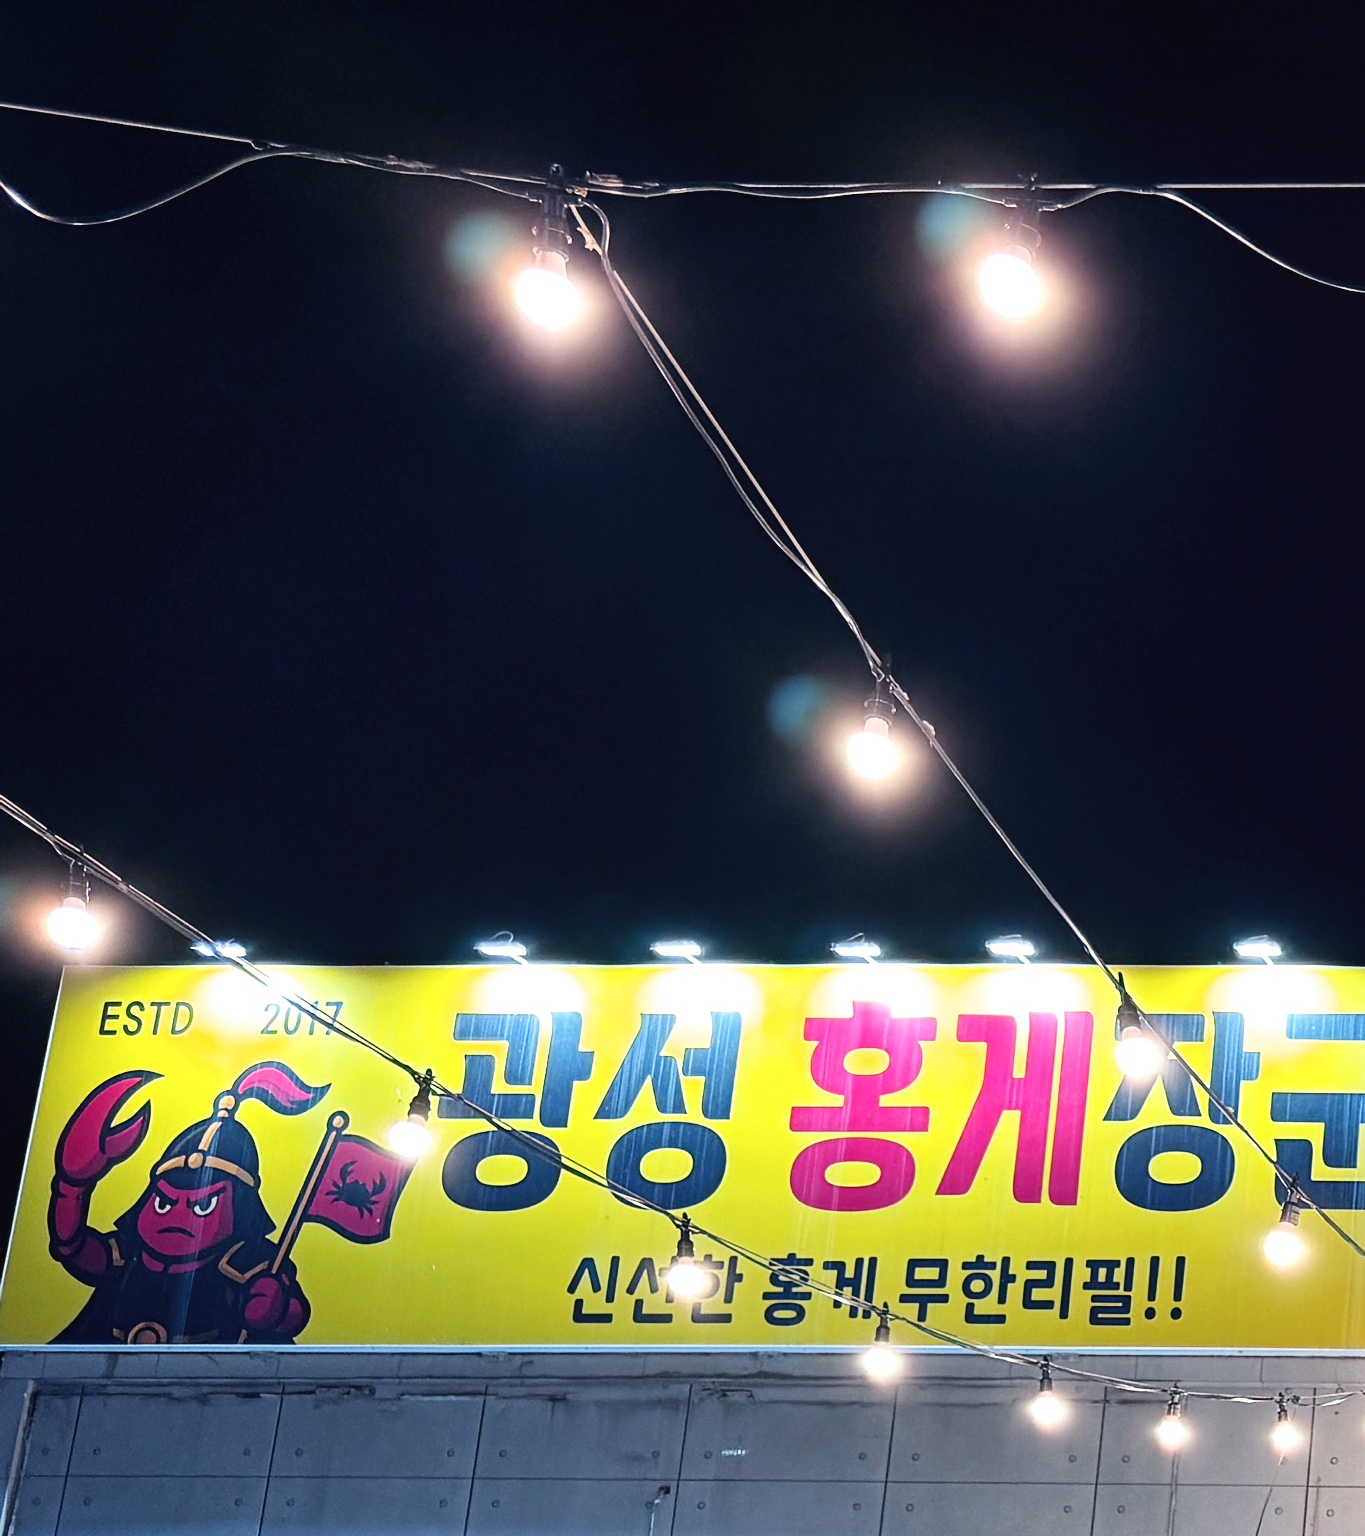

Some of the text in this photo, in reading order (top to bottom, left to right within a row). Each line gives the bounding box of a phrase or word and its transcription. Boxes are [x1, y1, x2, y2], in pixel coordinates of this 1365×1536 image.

[99, 1000, 344, 1036] ESTD 2017
[437, 1010, 744, 1212] 광성
[761, 1252, 878, 1327] 홍게
[902, 1254, 1187, 1328] 무한리필!!
